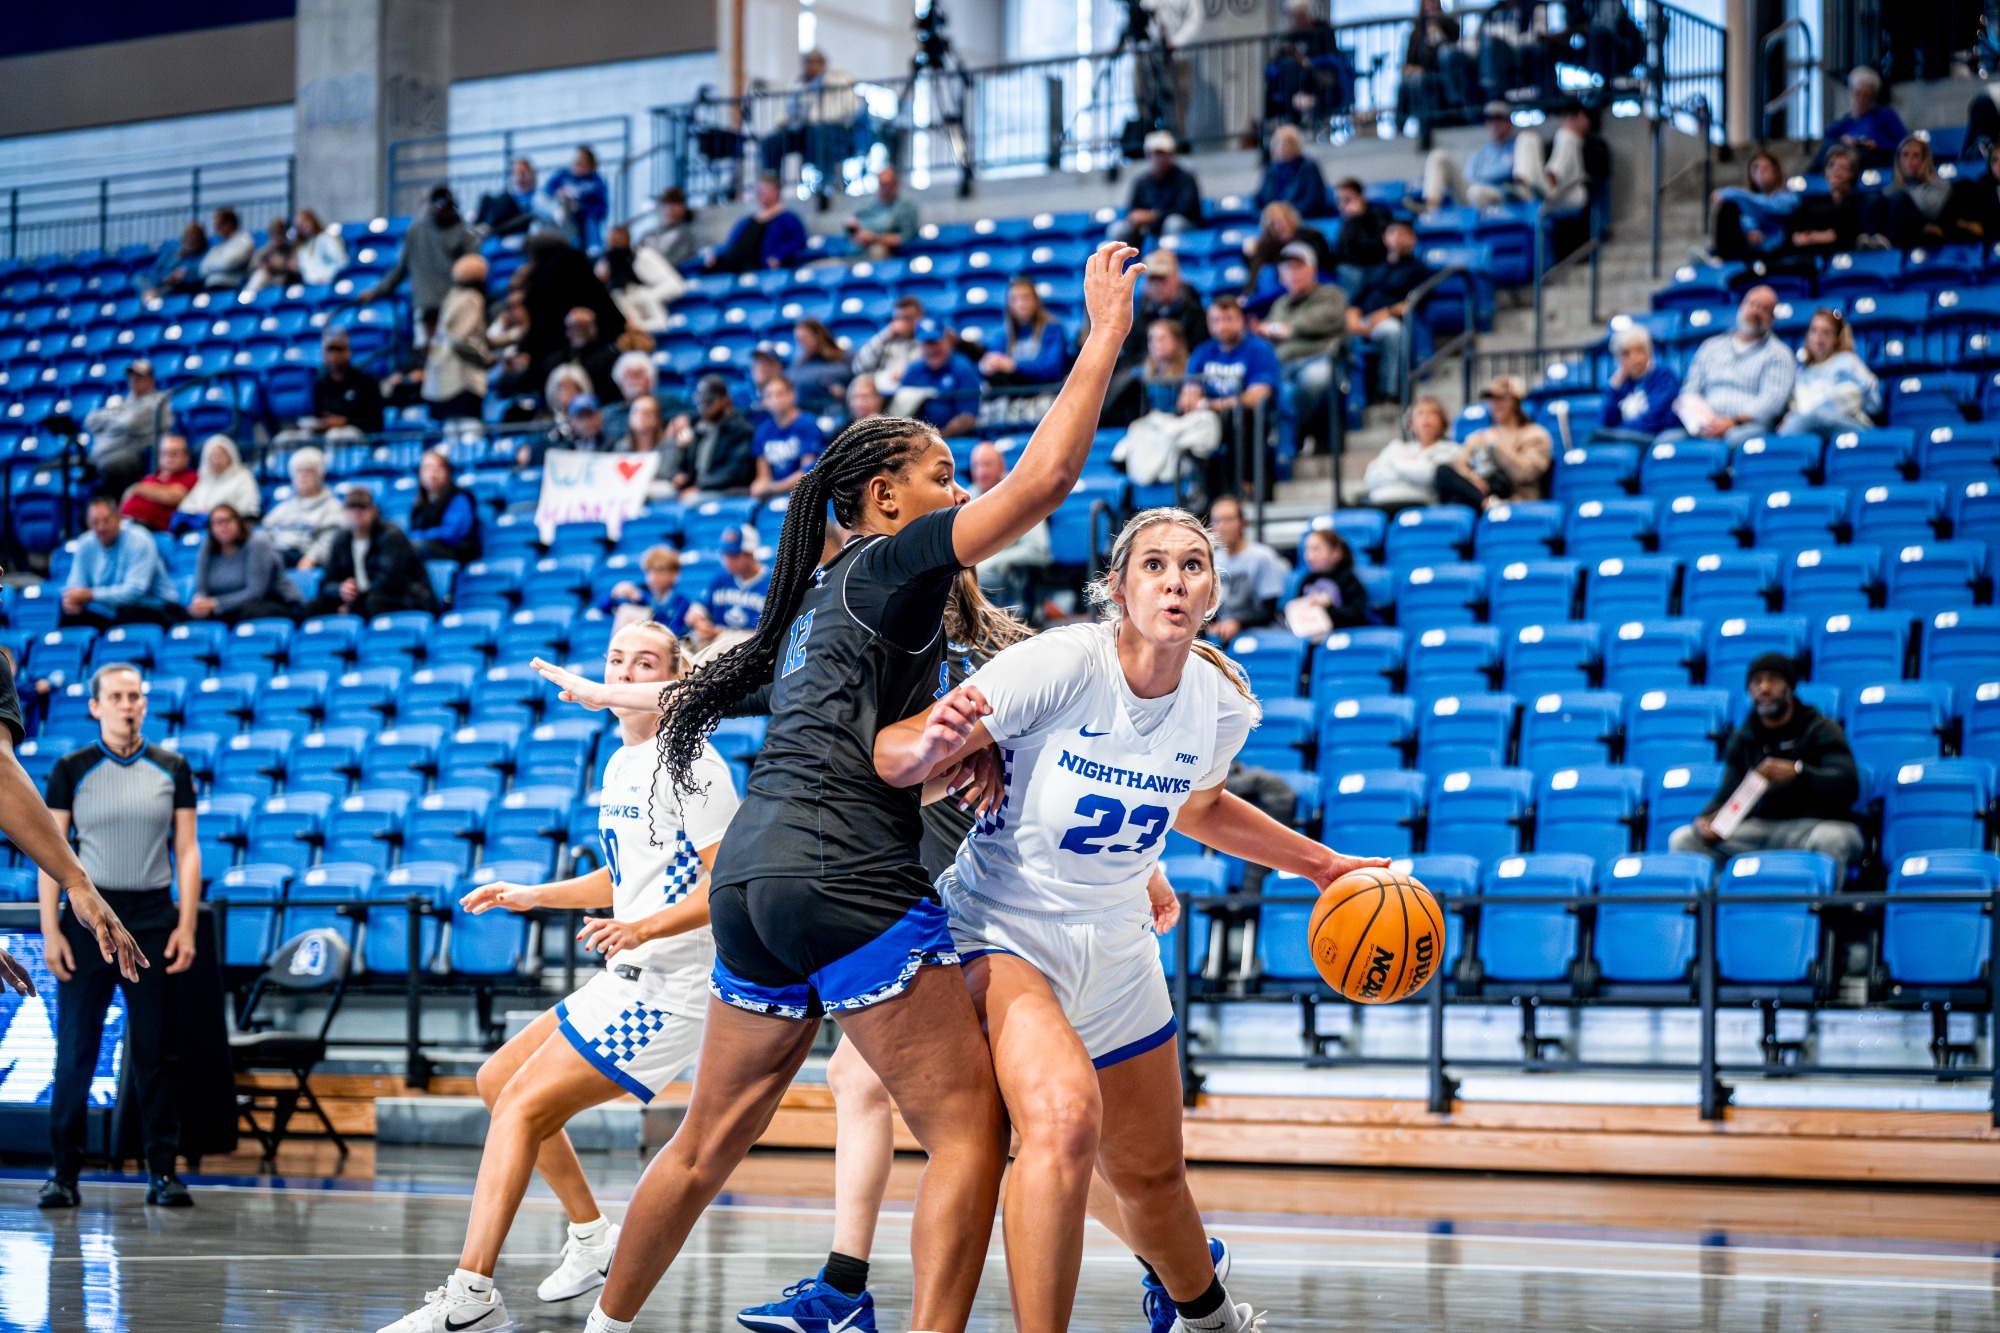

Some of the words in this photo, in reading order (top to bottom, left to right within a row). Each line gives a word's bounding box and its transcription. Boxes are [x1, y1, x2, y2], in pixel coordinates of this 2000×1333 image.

[781, 608, 816, 679] 12
[1057, 749, 1191, 794] NIGHTHAWKS
[1175, 752, 1199, 766] PBC
[1058, 793, 1170, 855] 23
[599, 828, 622, 887] 0
[1358, 945, 1395, 1000] NCAA
